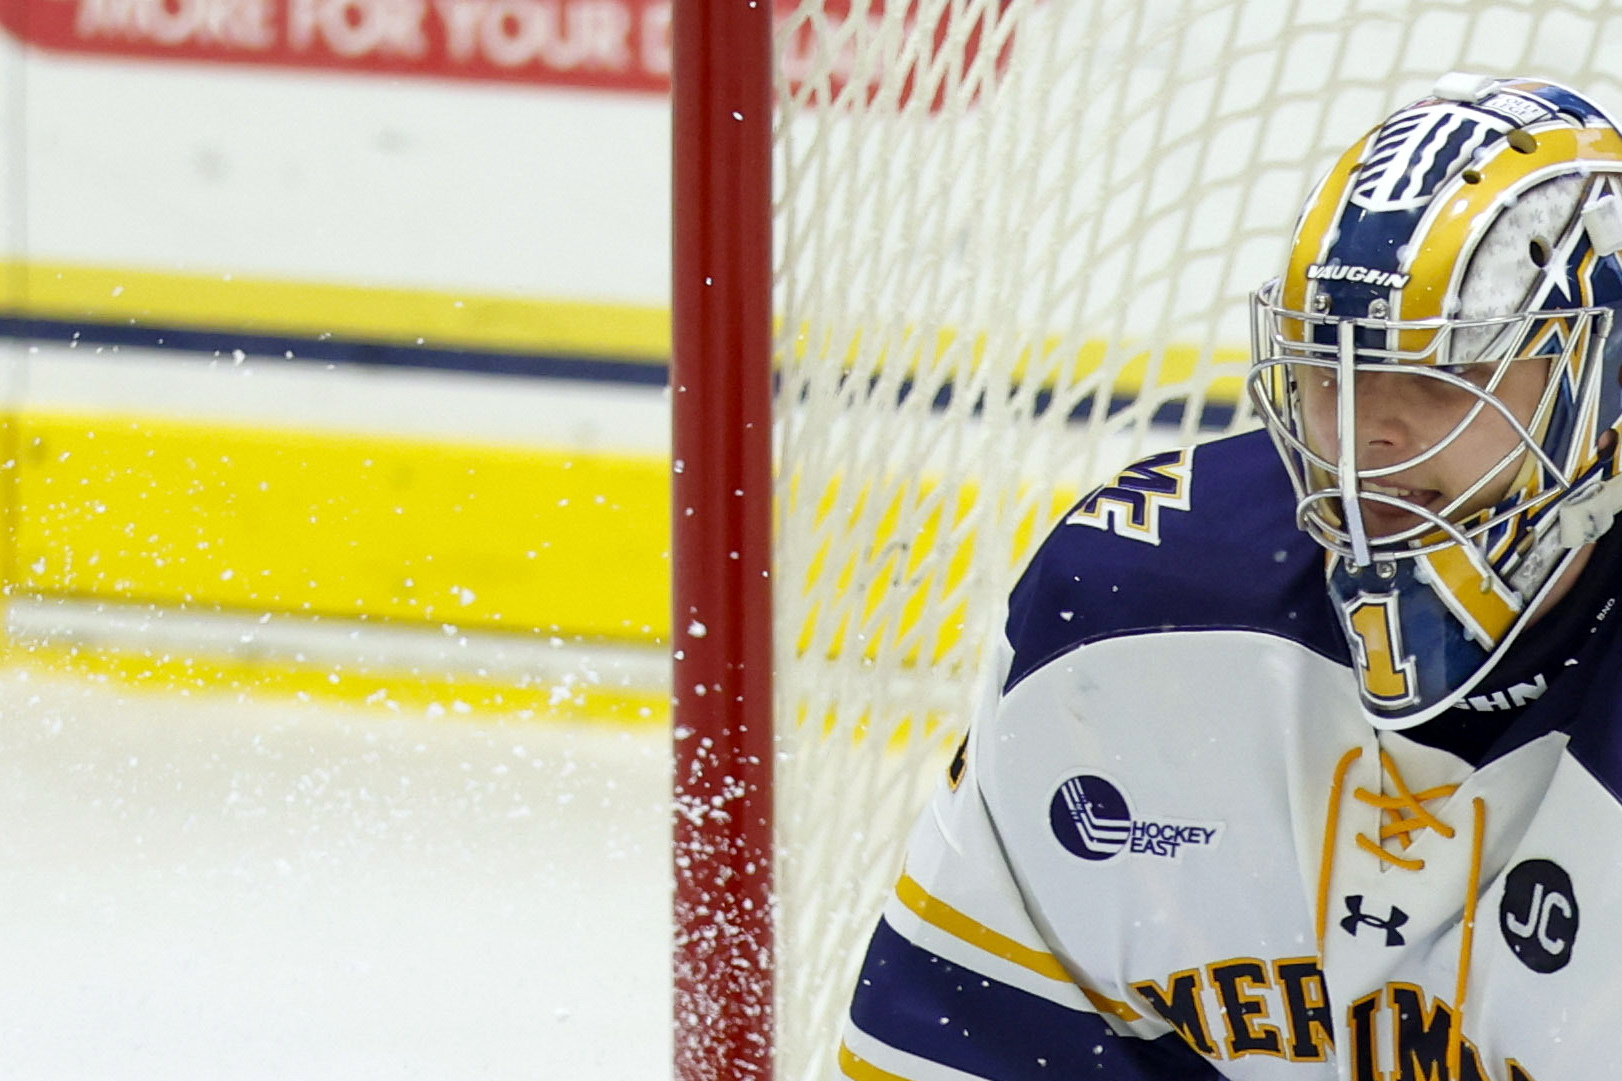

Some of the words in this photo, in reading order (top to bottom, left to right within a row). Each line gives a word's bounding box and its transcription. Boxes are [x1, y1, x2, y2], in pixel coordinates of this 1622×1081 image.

[1307, 264, 1410, 289] VAUGHN
[1346, 594, 1419, 706] 1
[1132, 821, 1216, 845] HOCKEY
[1130, 837, 1180, 859] EAST
[1506, 884, 1576, 957] JC
